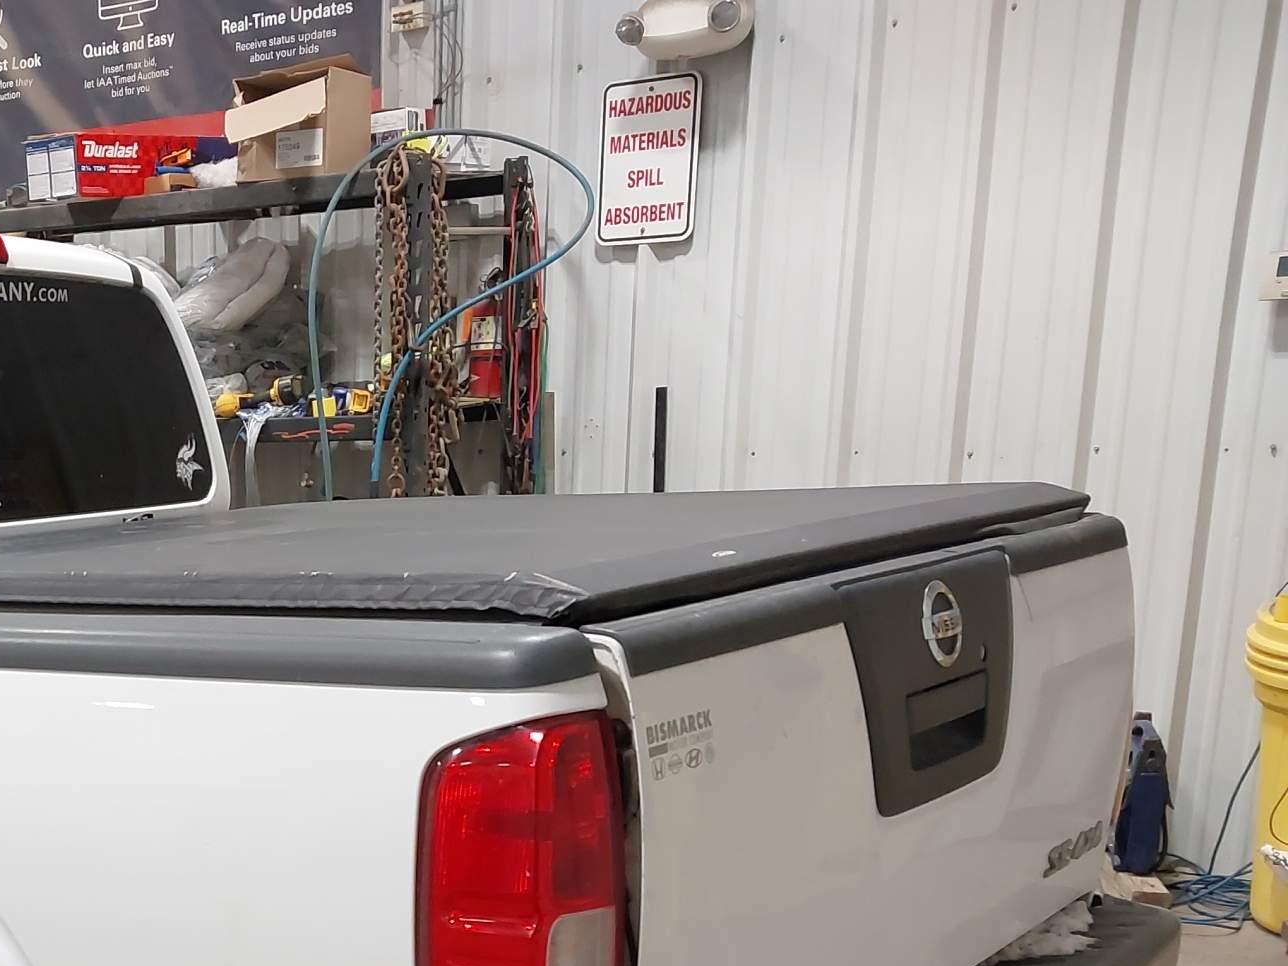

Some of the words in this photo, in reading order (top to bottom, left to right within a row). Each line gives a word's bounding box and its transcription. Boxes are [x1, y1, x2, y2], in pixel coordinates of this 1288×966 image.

[221, 12, 286, 35] Real-Time
[290, 1, 354, 25] Updates
[82, 40, 120, 58] Quick
[122, 35, 144, 52] and
[147, 32, 175, 47] Easy
[235, 38, 267, 52] Receive
[268, 33, 296, 46] status
[297, 28, 337, 42] updates
[11, 53, 42, 70] Look
[249, 51, 274, 63] about
[275, 48, 297, 61] your
[299, 43, 320, 55] bids
[102, 63, 124, 75] Insert
[125, 61, 142, 71] max
[143, 57, 157, 68] bid,
[15, 78, 33, 88] they
[84, 79, 95, 88] let
[96, 76, 113, 87] IAA
[113, 74, 136, 85] Timed
[111, 87, 124, 97] bid
[124, 86, 135, 95] for
[136, 85, 150, 97] you
[608, 90, 692, 118] HAZARDOUS
[81, 140, 139, 158] Duralast
[609, 128, 686, 154] MATERIALS
[627, 168, 664, 189] SPILL
[604, 202, 684, 226] ABSORBENT
[646, 709, 712, 745] BISMARCK
